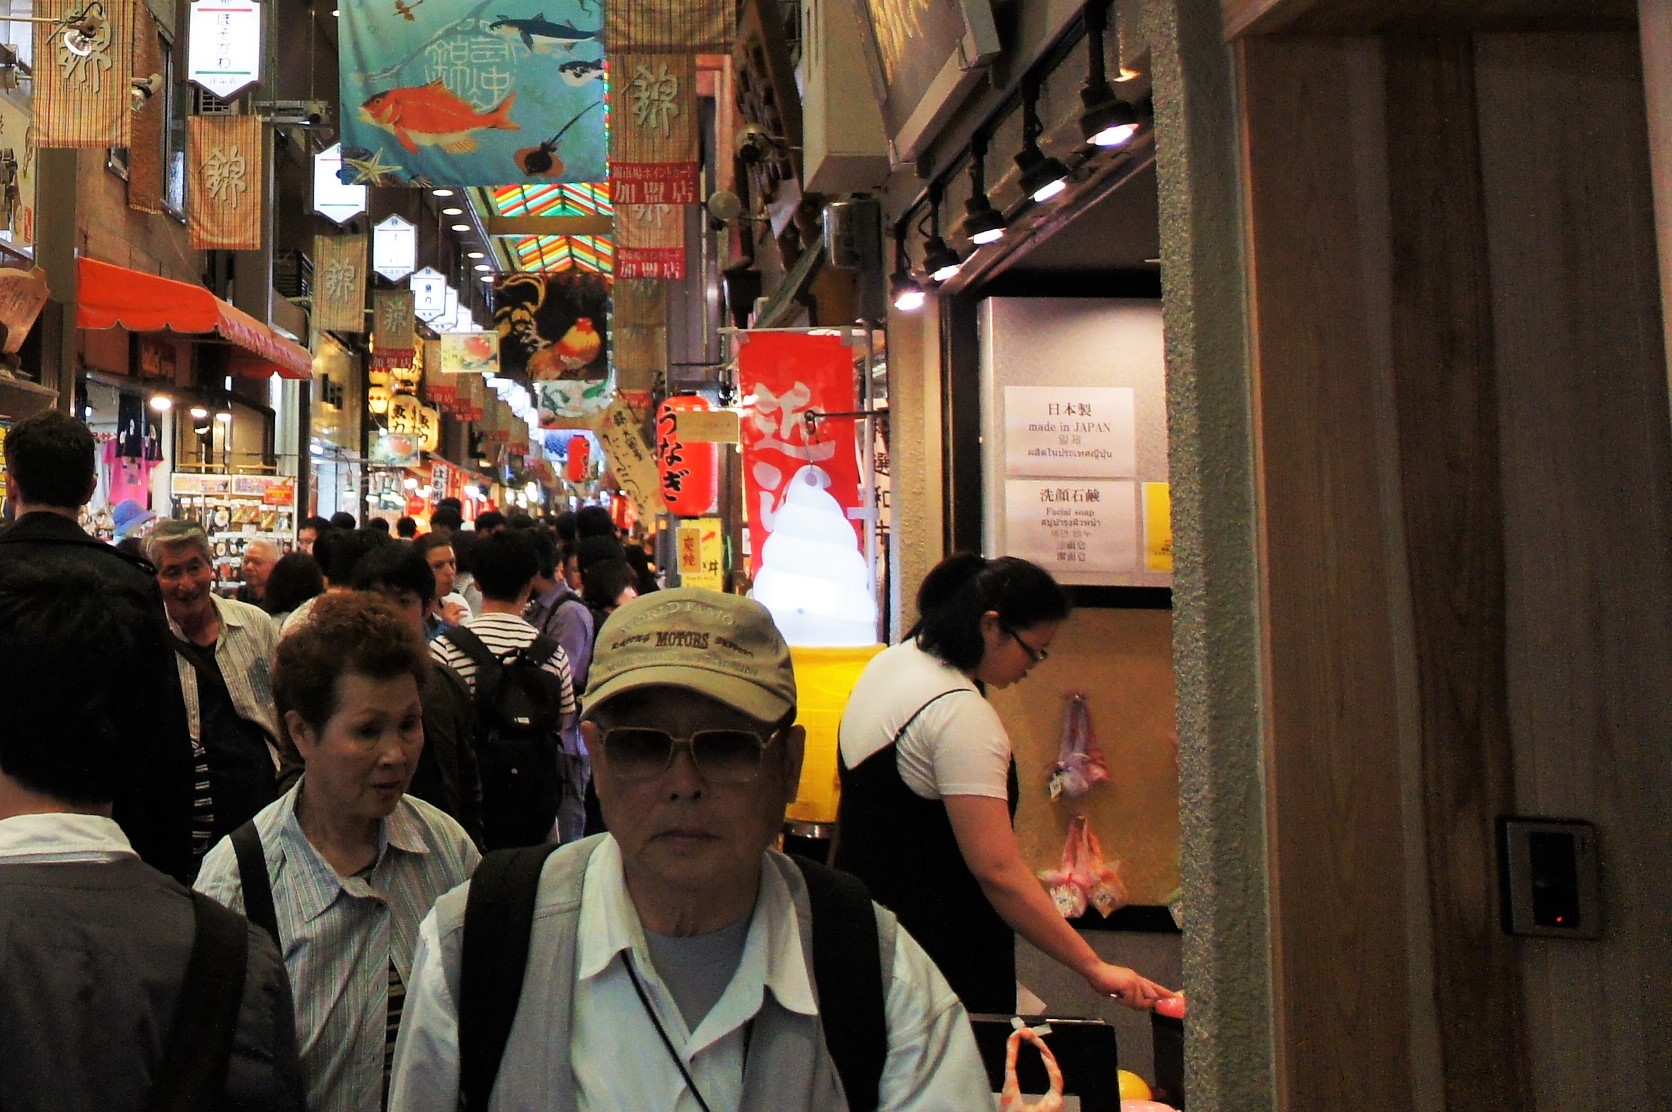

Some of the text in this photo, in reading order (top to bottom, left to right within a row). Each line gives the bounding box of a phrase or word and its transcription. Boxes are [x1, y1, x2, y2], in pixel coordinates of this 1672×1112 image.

[614, 180, 695, 204] 加盟店
[619, 261, 680, 280] 加盟店
[1048, 402, 1092, 417] 日本製
[1028, 422, 1111, 432] made in JAPAN
[657, 405, 692, 504] うなぎ
[1046, 507, 1095, 518] Facial soap
[654, 630, 710, 650] MOTORS
